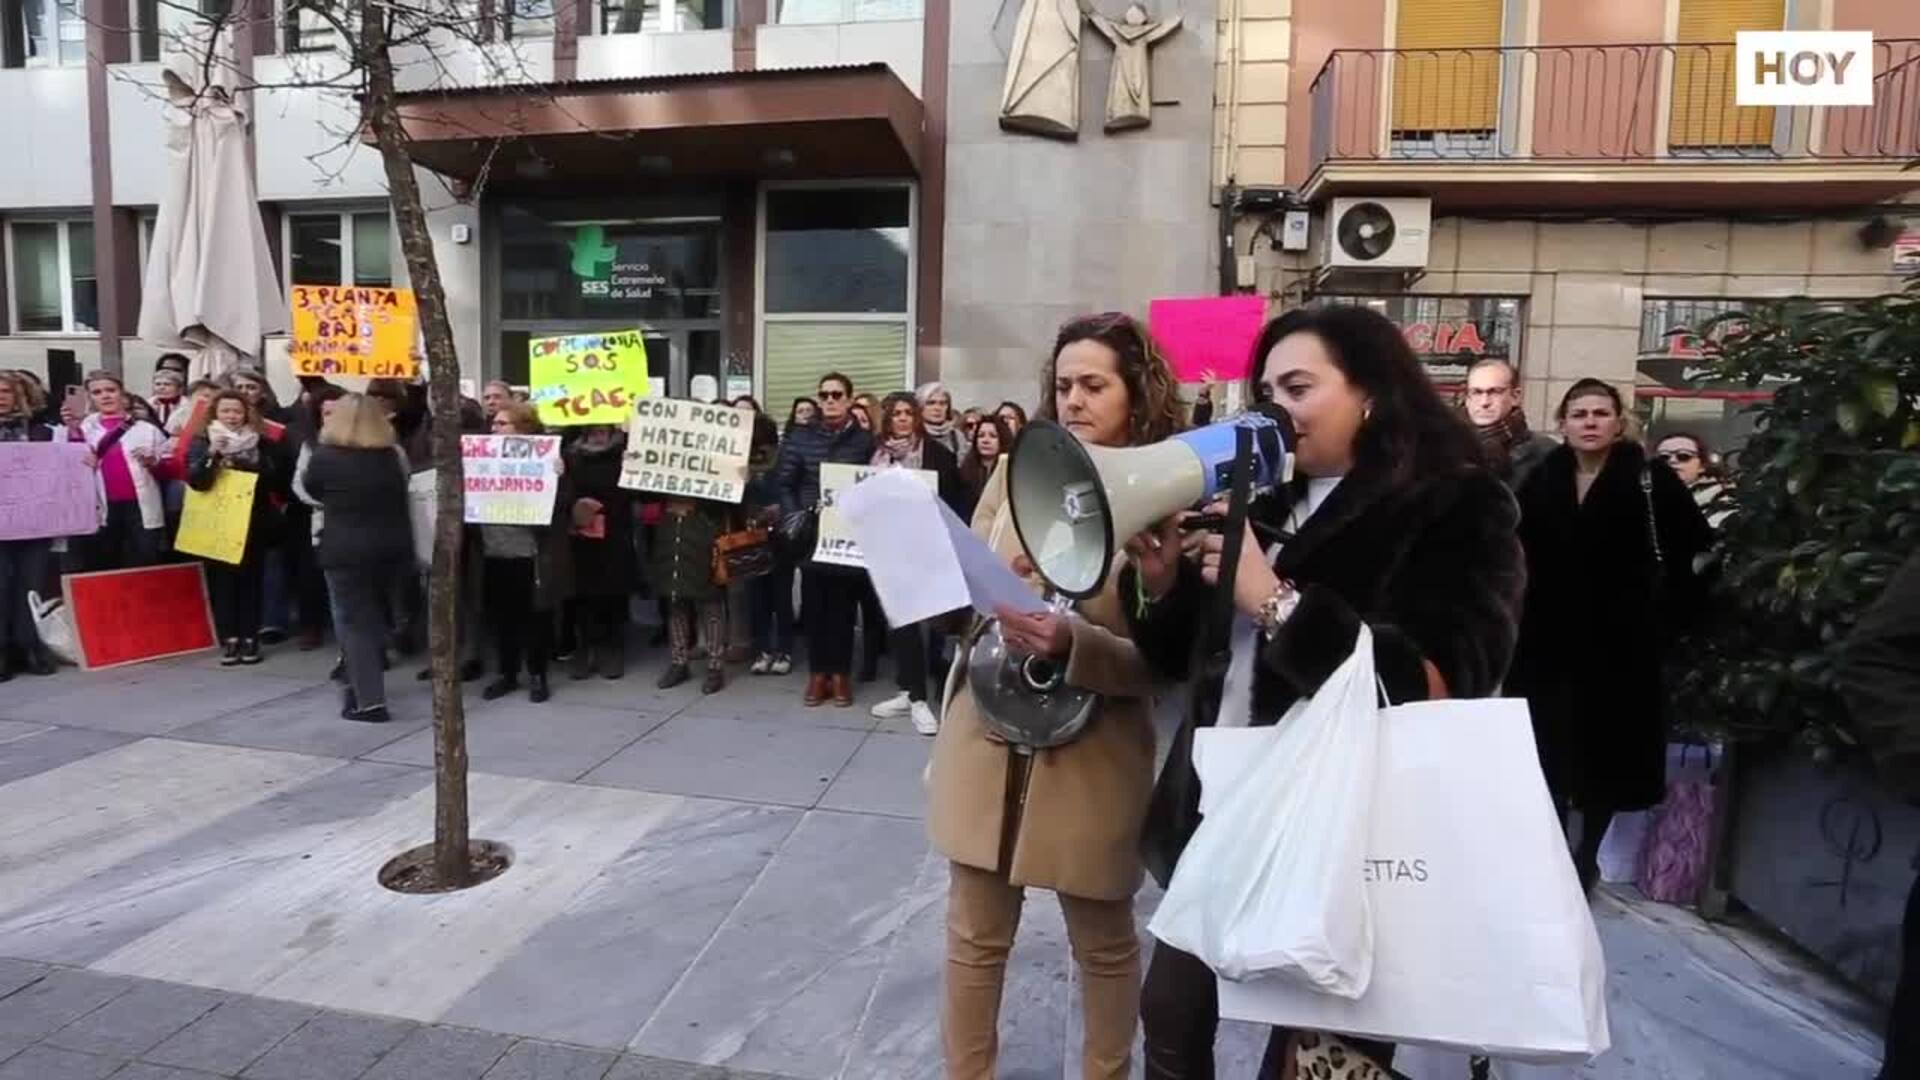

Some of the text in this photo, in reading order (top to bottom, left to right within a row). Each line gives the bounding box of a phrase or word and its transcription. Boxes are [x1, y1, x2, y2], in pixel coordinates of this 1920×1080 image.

[611, 260, 650, 272] Servicio
[581, 280, 610, 295] SES
[610, 286, 652, 299] de Salud
[318, 287, 399, 307] PLANTA
[318, 320, 373, 338] BAJO
[637, 400, 740, 428] CON POCO
[624, 468, 733, 499] TRABAJAR
